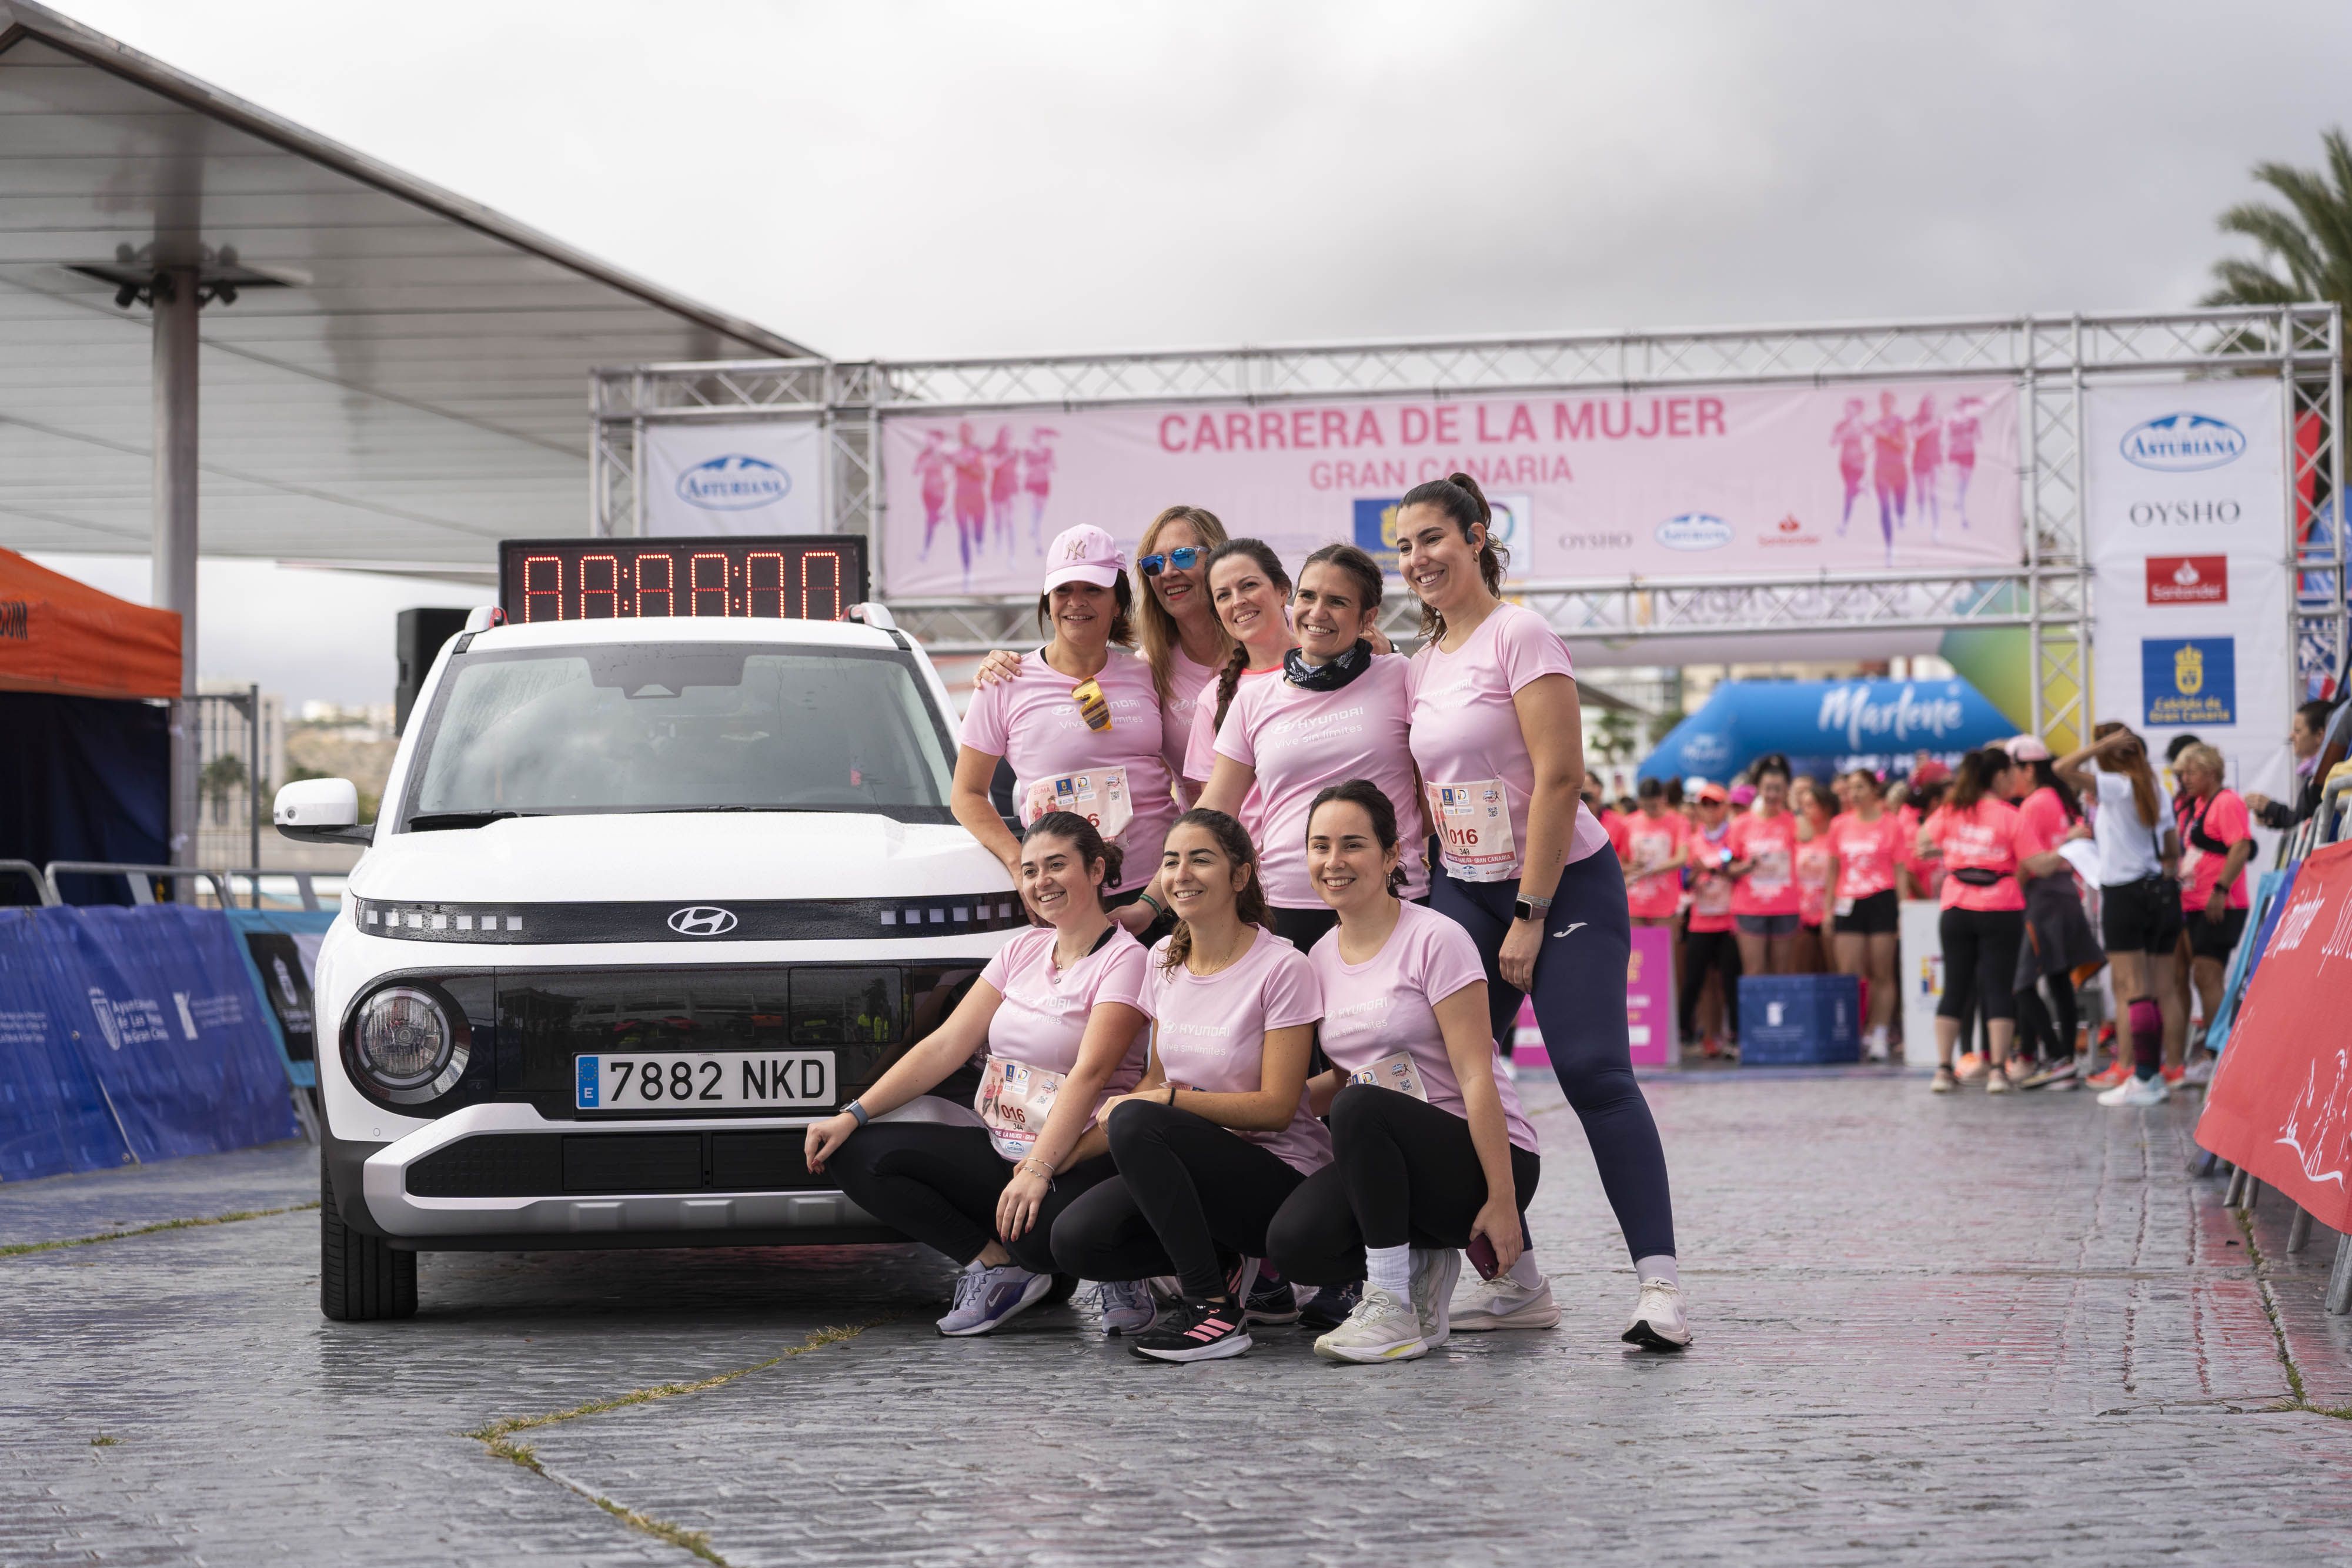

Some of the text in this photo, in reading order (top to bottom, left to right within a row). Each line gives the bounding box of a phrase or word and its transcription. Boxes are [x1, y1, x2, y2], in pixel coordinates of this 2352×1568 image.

[1158, 397, 1727, 453] CARRERA DE LA MUJER
[2130, 435, 2236, 460] ASTURIANA
[1310, 455, 1574, 490] GRAN CANARIA
[2129, 499, 2241, 527] OYSHO
[1298, 706, 1364, 729] HYUNDAI
[1449, 828, 1478, 845] 016
[1487, 854, 1511, 862] CANARIA
[1179, 1023, 1231, 1037] HYUNDAI
[584, 1059, 824, 1102] E 7882 NKD
[1001, 1104, 1025, 1123] 016
